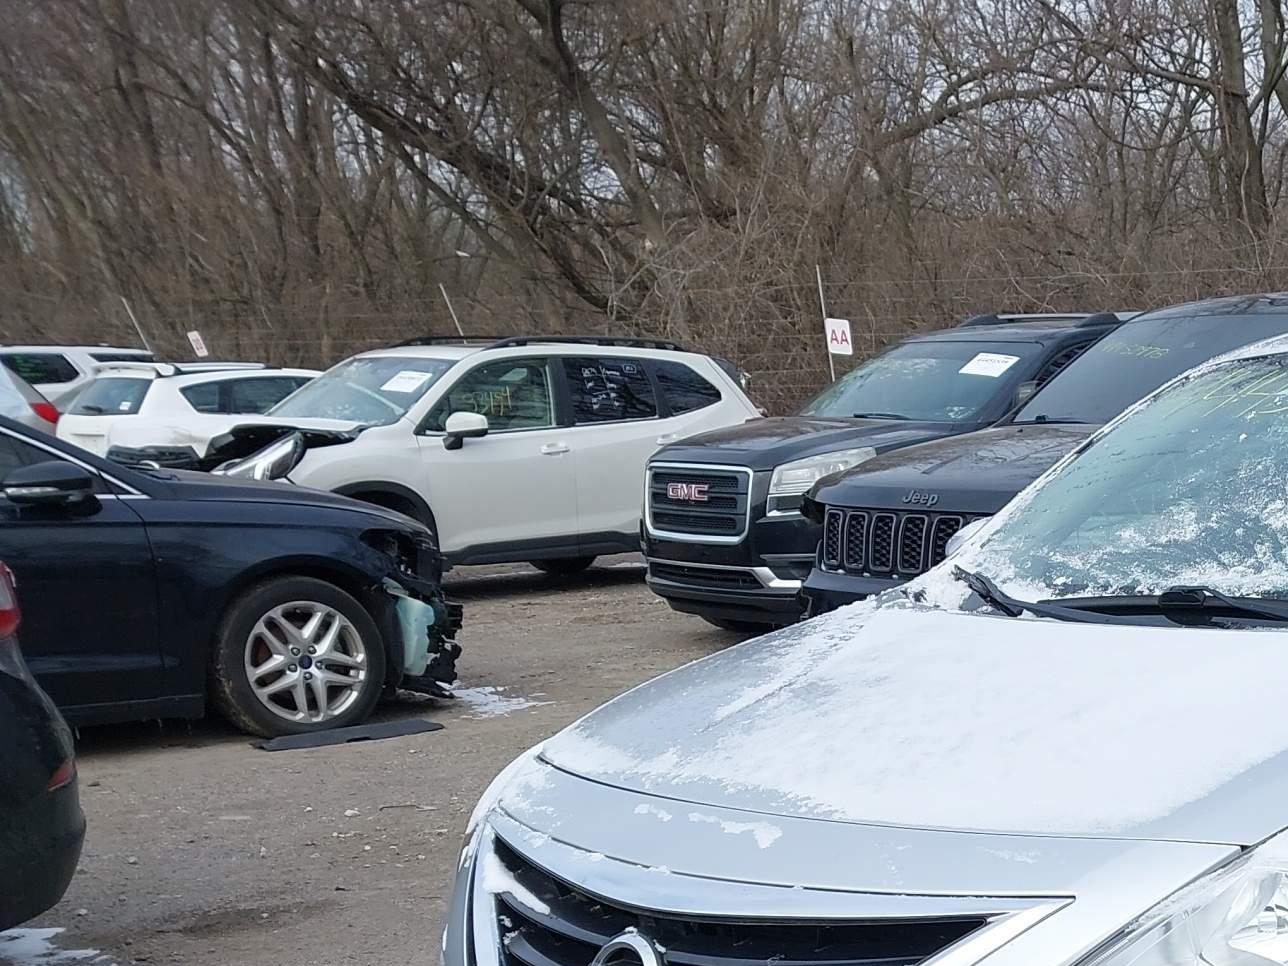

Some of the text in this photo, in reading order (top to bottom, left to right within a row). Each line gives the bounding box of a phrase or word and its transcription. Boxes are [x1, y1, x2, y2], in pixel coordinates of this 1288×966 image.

[830, 329, 850, 345] AA
[667, 483, 708, 501] GMC
[902, 490, 938, 507] Jeep
